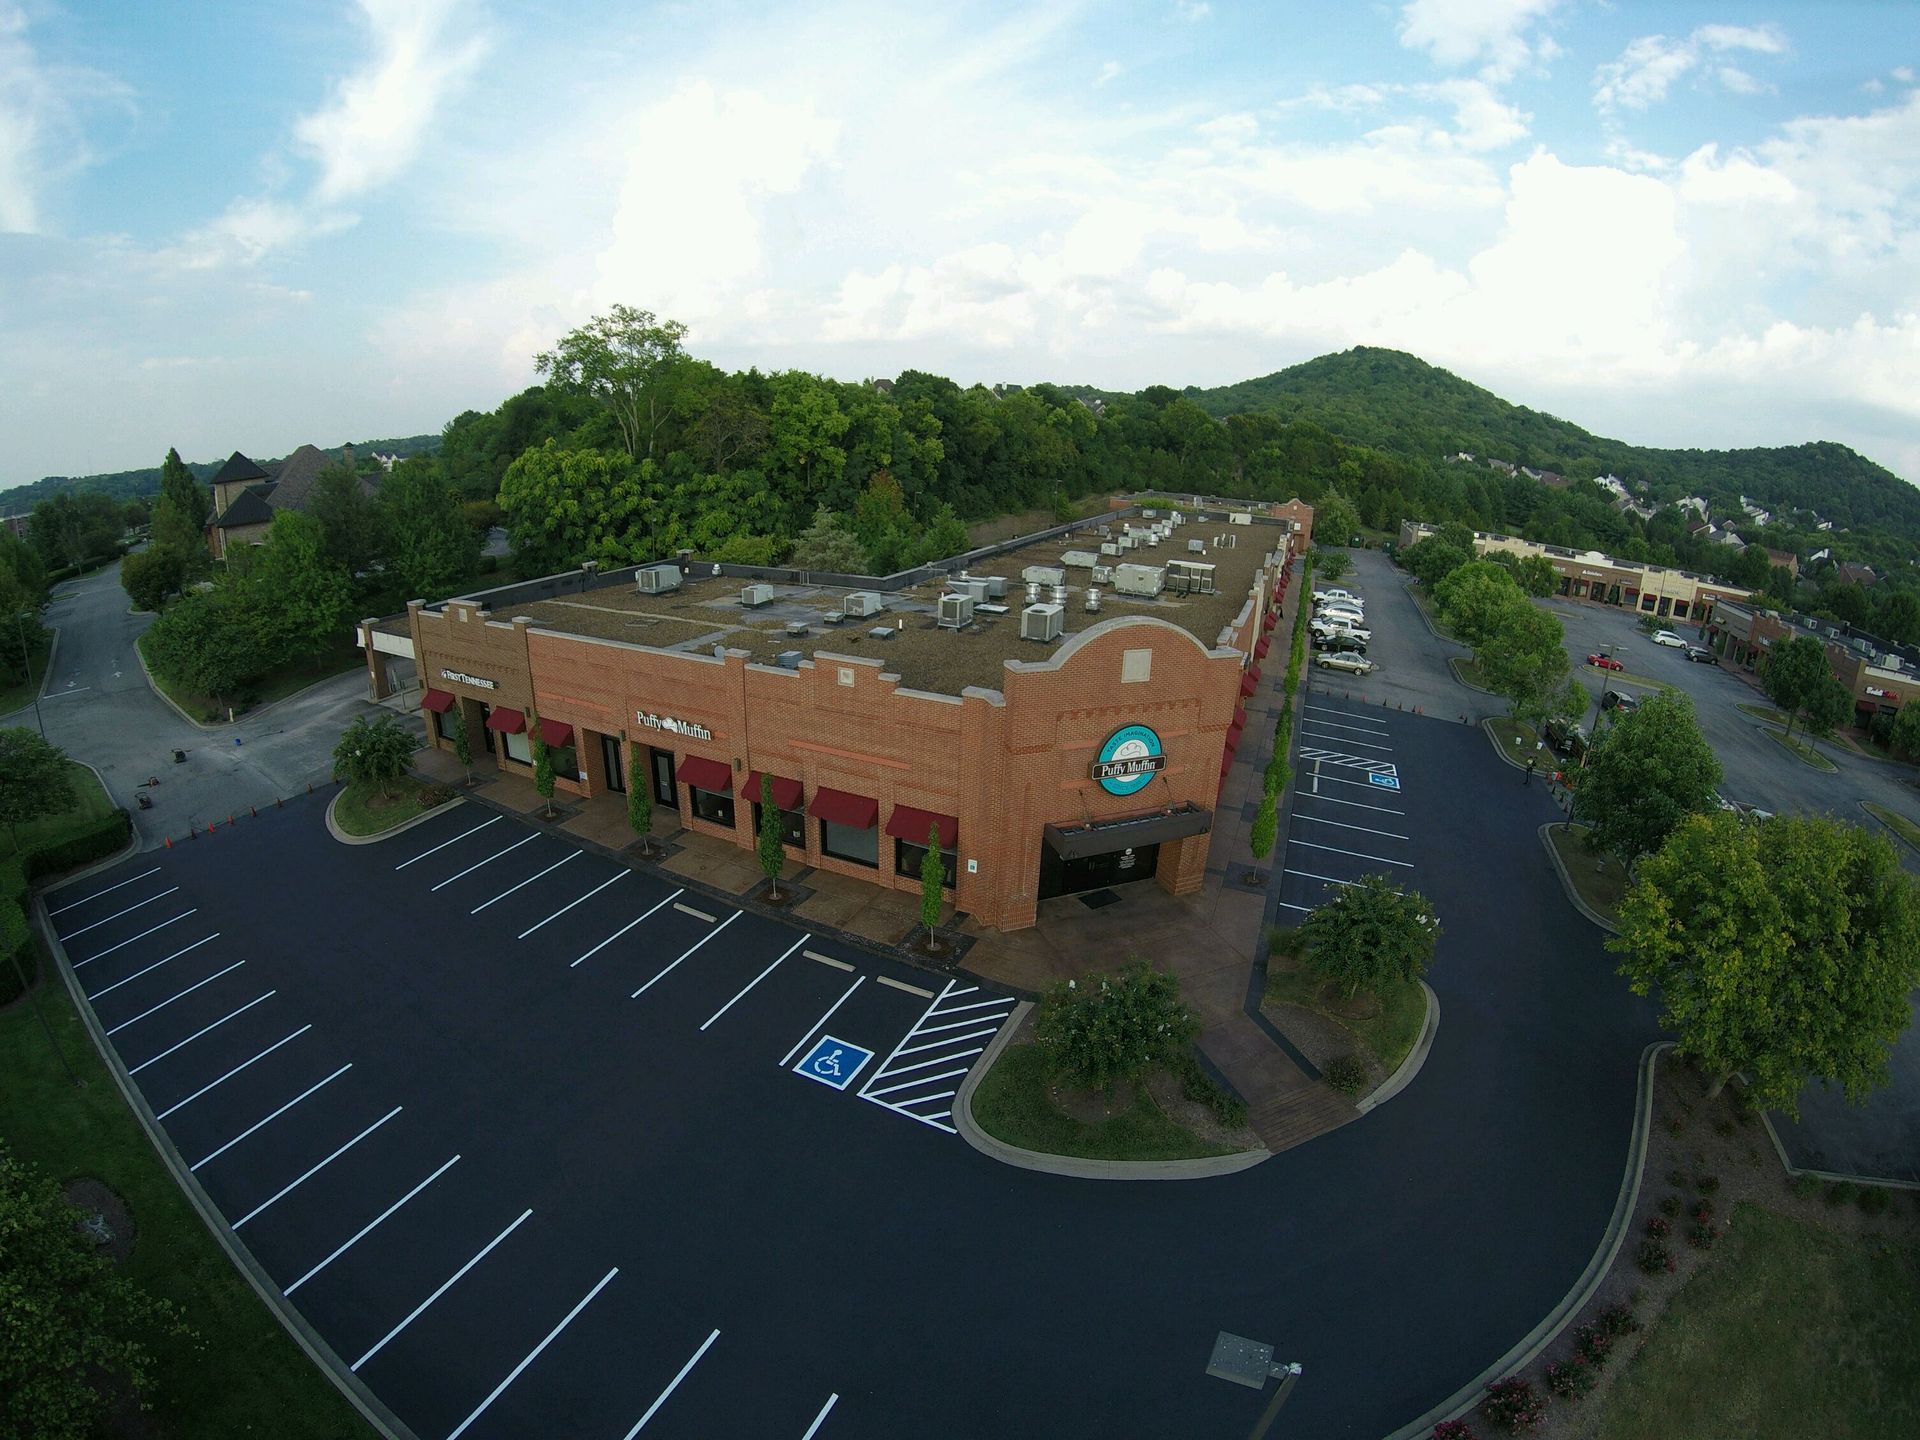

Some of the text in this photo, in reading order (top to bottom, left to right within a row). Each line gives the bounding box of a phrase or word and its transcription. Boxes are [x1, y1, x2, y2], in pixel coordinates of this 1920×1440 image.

[636, 711, 712, 740] Puffy Muffin
[1101, 759, 1156, 777] Puffy Muffin
